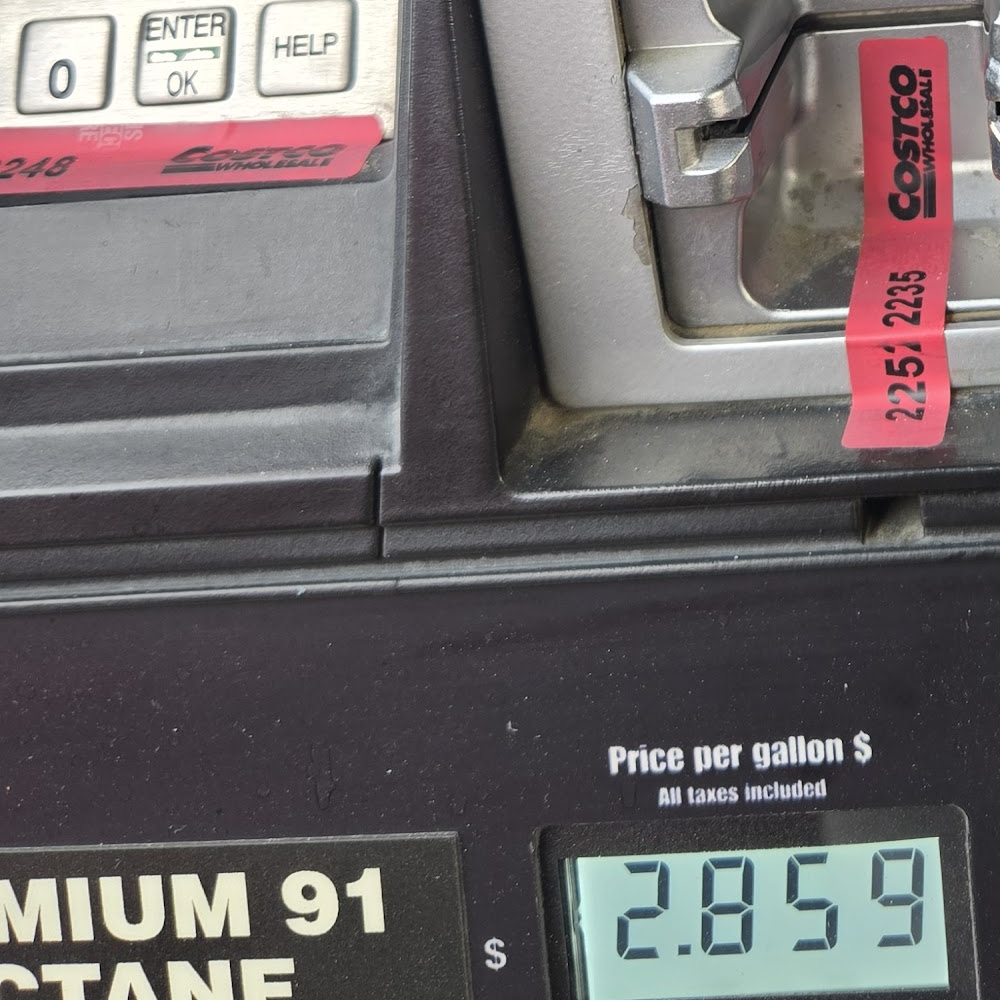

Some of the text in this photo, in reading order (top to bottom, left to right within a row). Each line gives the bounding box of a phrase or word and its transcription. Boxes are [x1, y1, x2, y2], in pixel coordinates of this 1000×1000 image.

[145, 12, 226, 41] ENTER
[274, 33, 339, 59] HELP
[48, 58, 76, 99] 0
[167, 70, 198, 96] OK
[921, 68, 934, 171] WHOLESALE
[171, 143, 348, 163] COSTCO
[887, 64, 919, 222] COSTCO
[0, 154, 79, 179] 248
[608, 730, 873, 777] Price per gallon $
[658, 778, 828, 808] All taxes included
[281, 867, 385, 937] 91
[616, 847, 925, 960] 2.859
[484, 937, 507, 971] $
